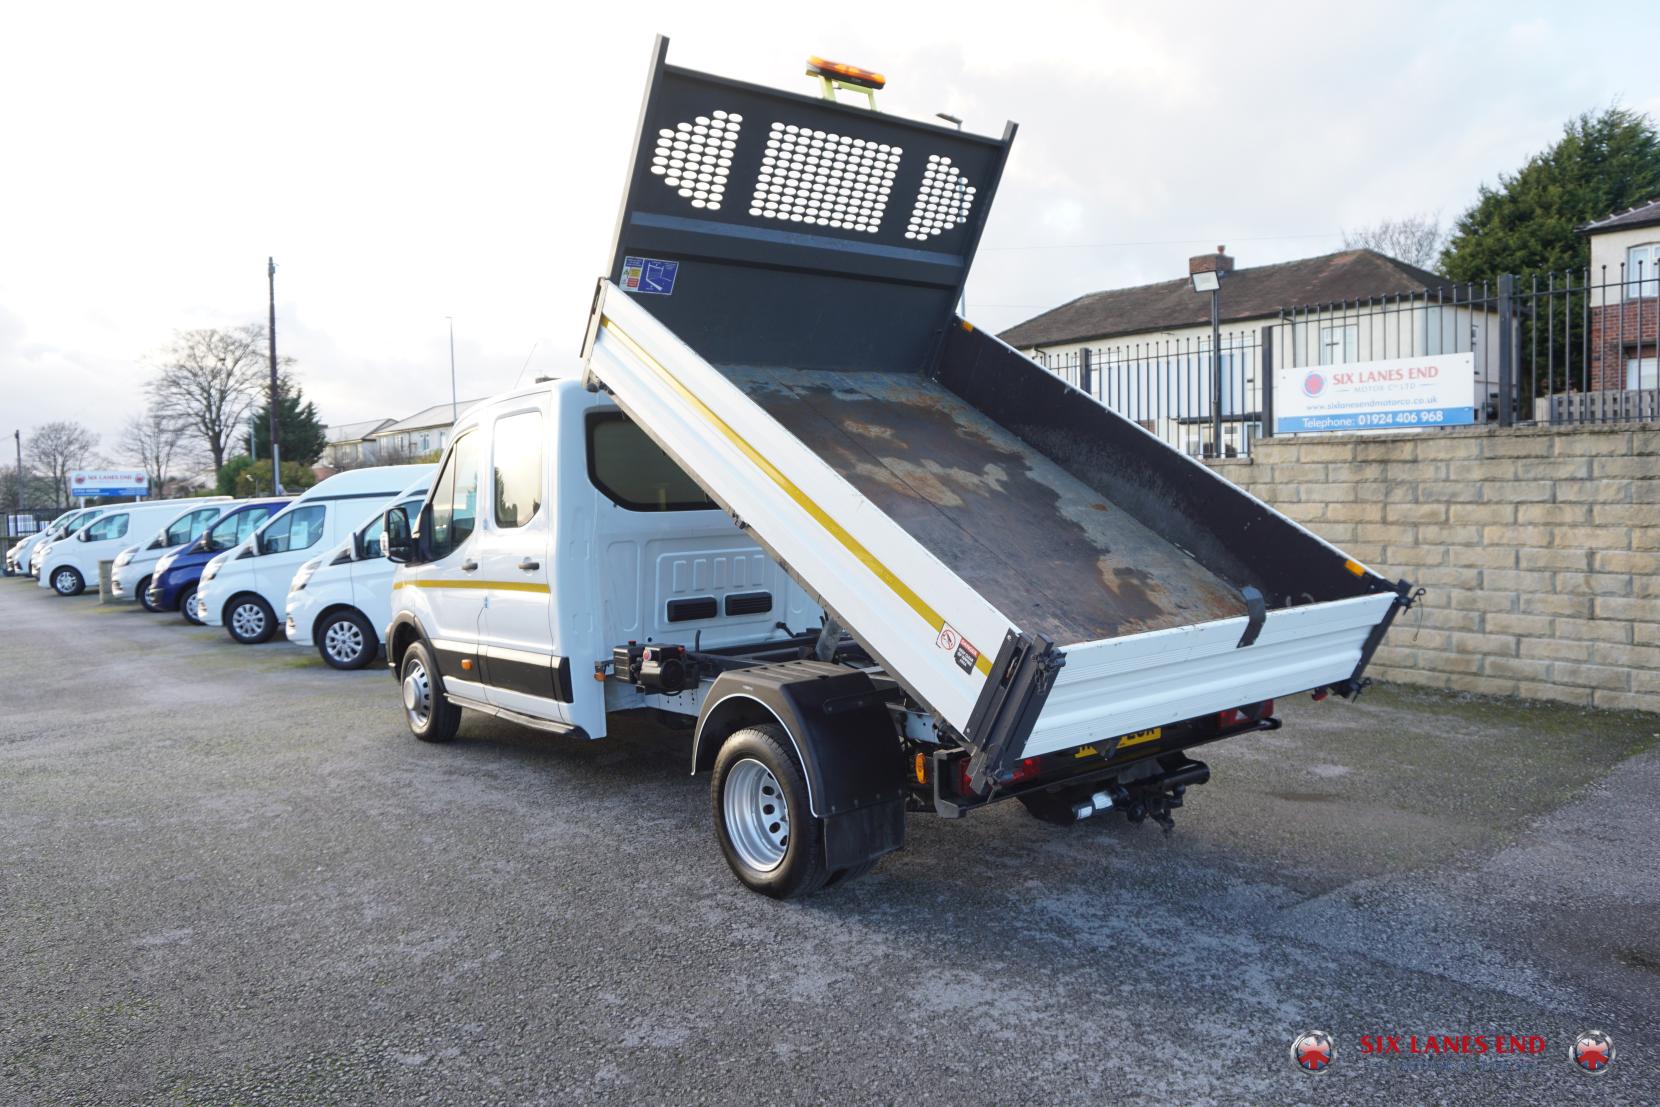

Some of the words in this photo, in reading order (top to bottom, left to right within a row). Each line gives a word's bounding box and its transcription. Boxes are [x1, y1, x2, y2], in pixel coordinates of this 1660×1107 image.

[1332, 372, 1354, 385] SIX
[1359, 368, 1404, 383] LANES
[1408, 366, 1439, 379] END
[1354, 385, 1384, 393] MOTOR
[1400, 383, 1416, 391] LTD
[1306, 396, 1438, 411] www.sixlanesendmotorco.co.uk
[1303, 417, 1355, 429] Telephone:
[1358, 413, 1393, 425] 01924
[1396, 411, 1418, 424] 406
[1421, 410, 1444, 422] 968
